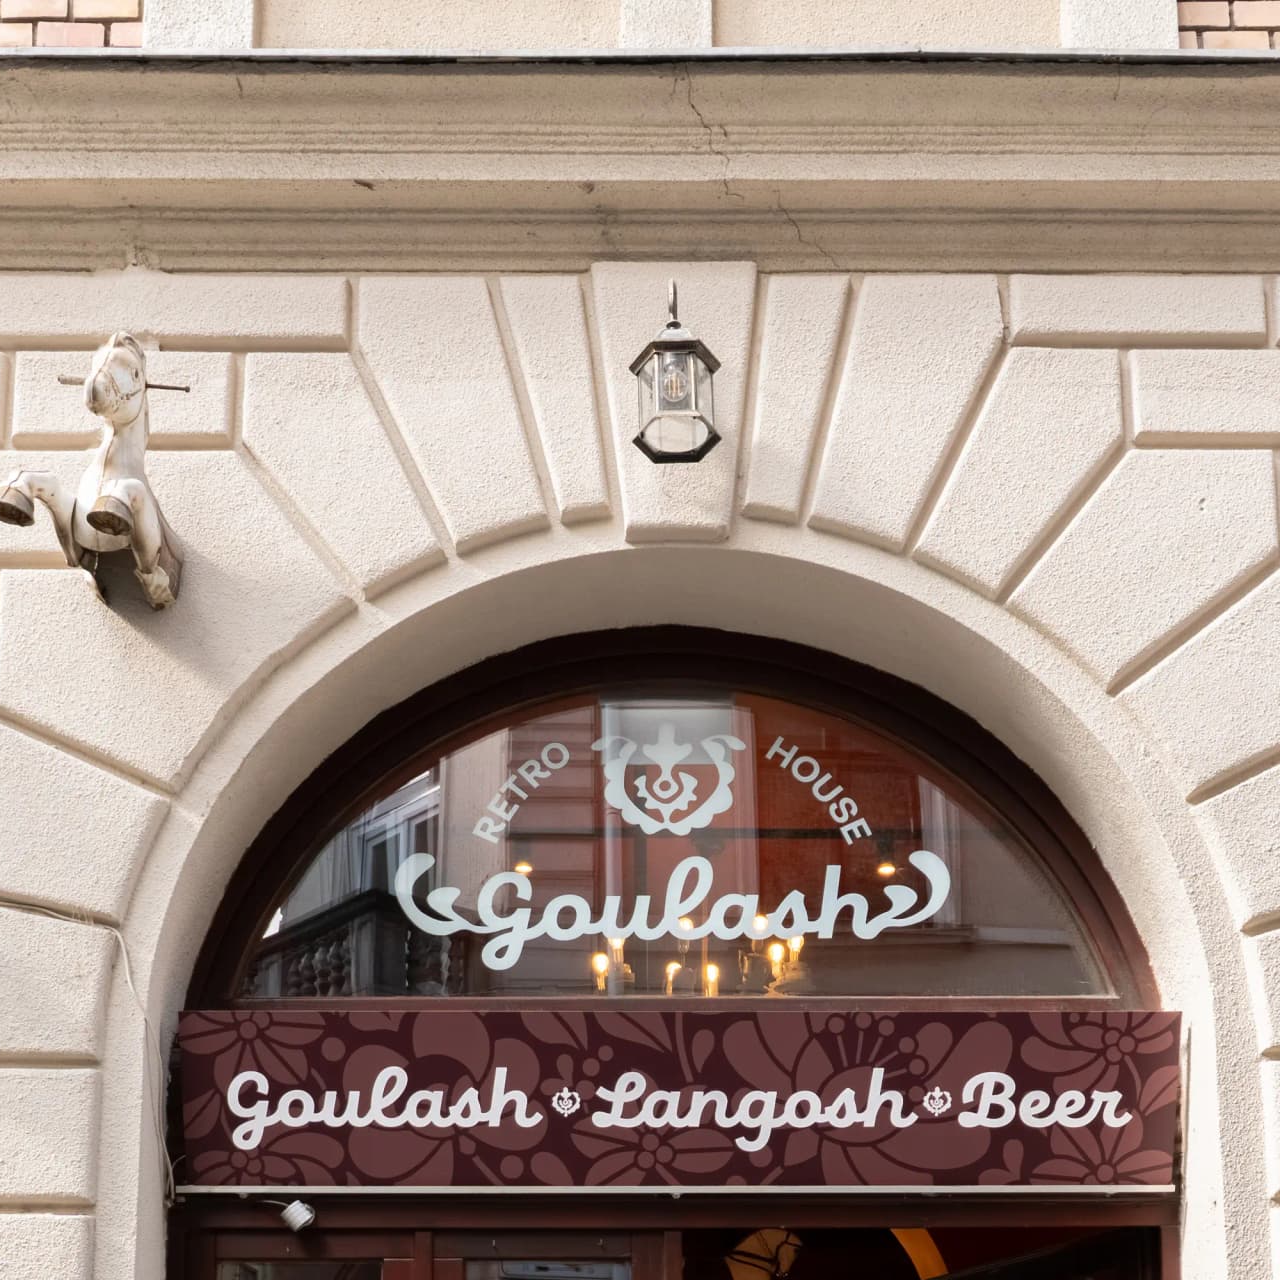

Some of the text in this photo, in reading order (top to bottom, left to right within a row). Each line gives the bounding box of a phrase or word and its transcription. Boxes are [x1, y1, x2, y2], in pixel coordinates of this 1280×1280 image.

[472, 741, 570, 844] RETRO
[764, 735, 872, 845] HOUSE
[475, 855, 895, 971] Goulash
[225, 1066, 1134, 1152] Goulash Langosh Beer
